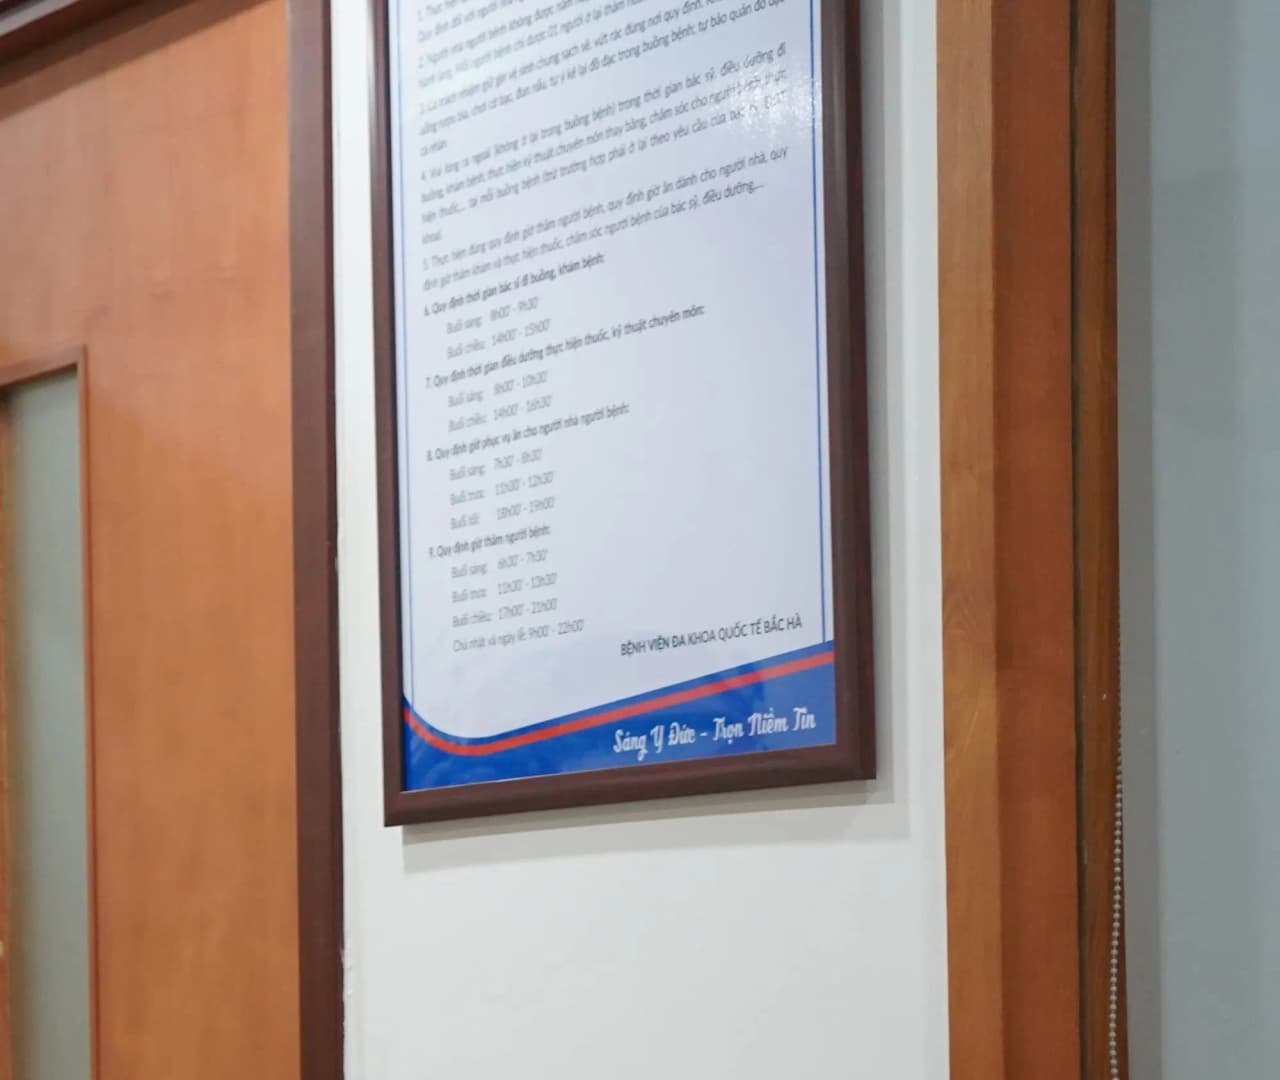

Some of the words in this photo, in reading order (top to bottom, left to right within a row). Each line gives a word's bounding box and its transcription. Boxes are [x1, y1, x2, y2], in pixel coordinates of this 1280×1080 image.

[620, 641, 646, 656] BỆNH
[648, 637, 670, 653] VIỆN
[671, 635, 686, 648] ĐA
[688, 631, 717, 646] KHOA
[718, 624, 747, 643] QUỐC
[749, 620, 763, 636] TẾ
[764, 617, 785, 634] BẮC
[787, 615, 802, 630] HÀ
[613, 728, 648, 761] Sáng
[650, 725, 665, 754] Y
[668, 721, 696, 747] Đức
[713, 717, 744, 745] Trọn
[748, 707, 789, 735] Niềm
[793, 706, 817, 731] Tin
